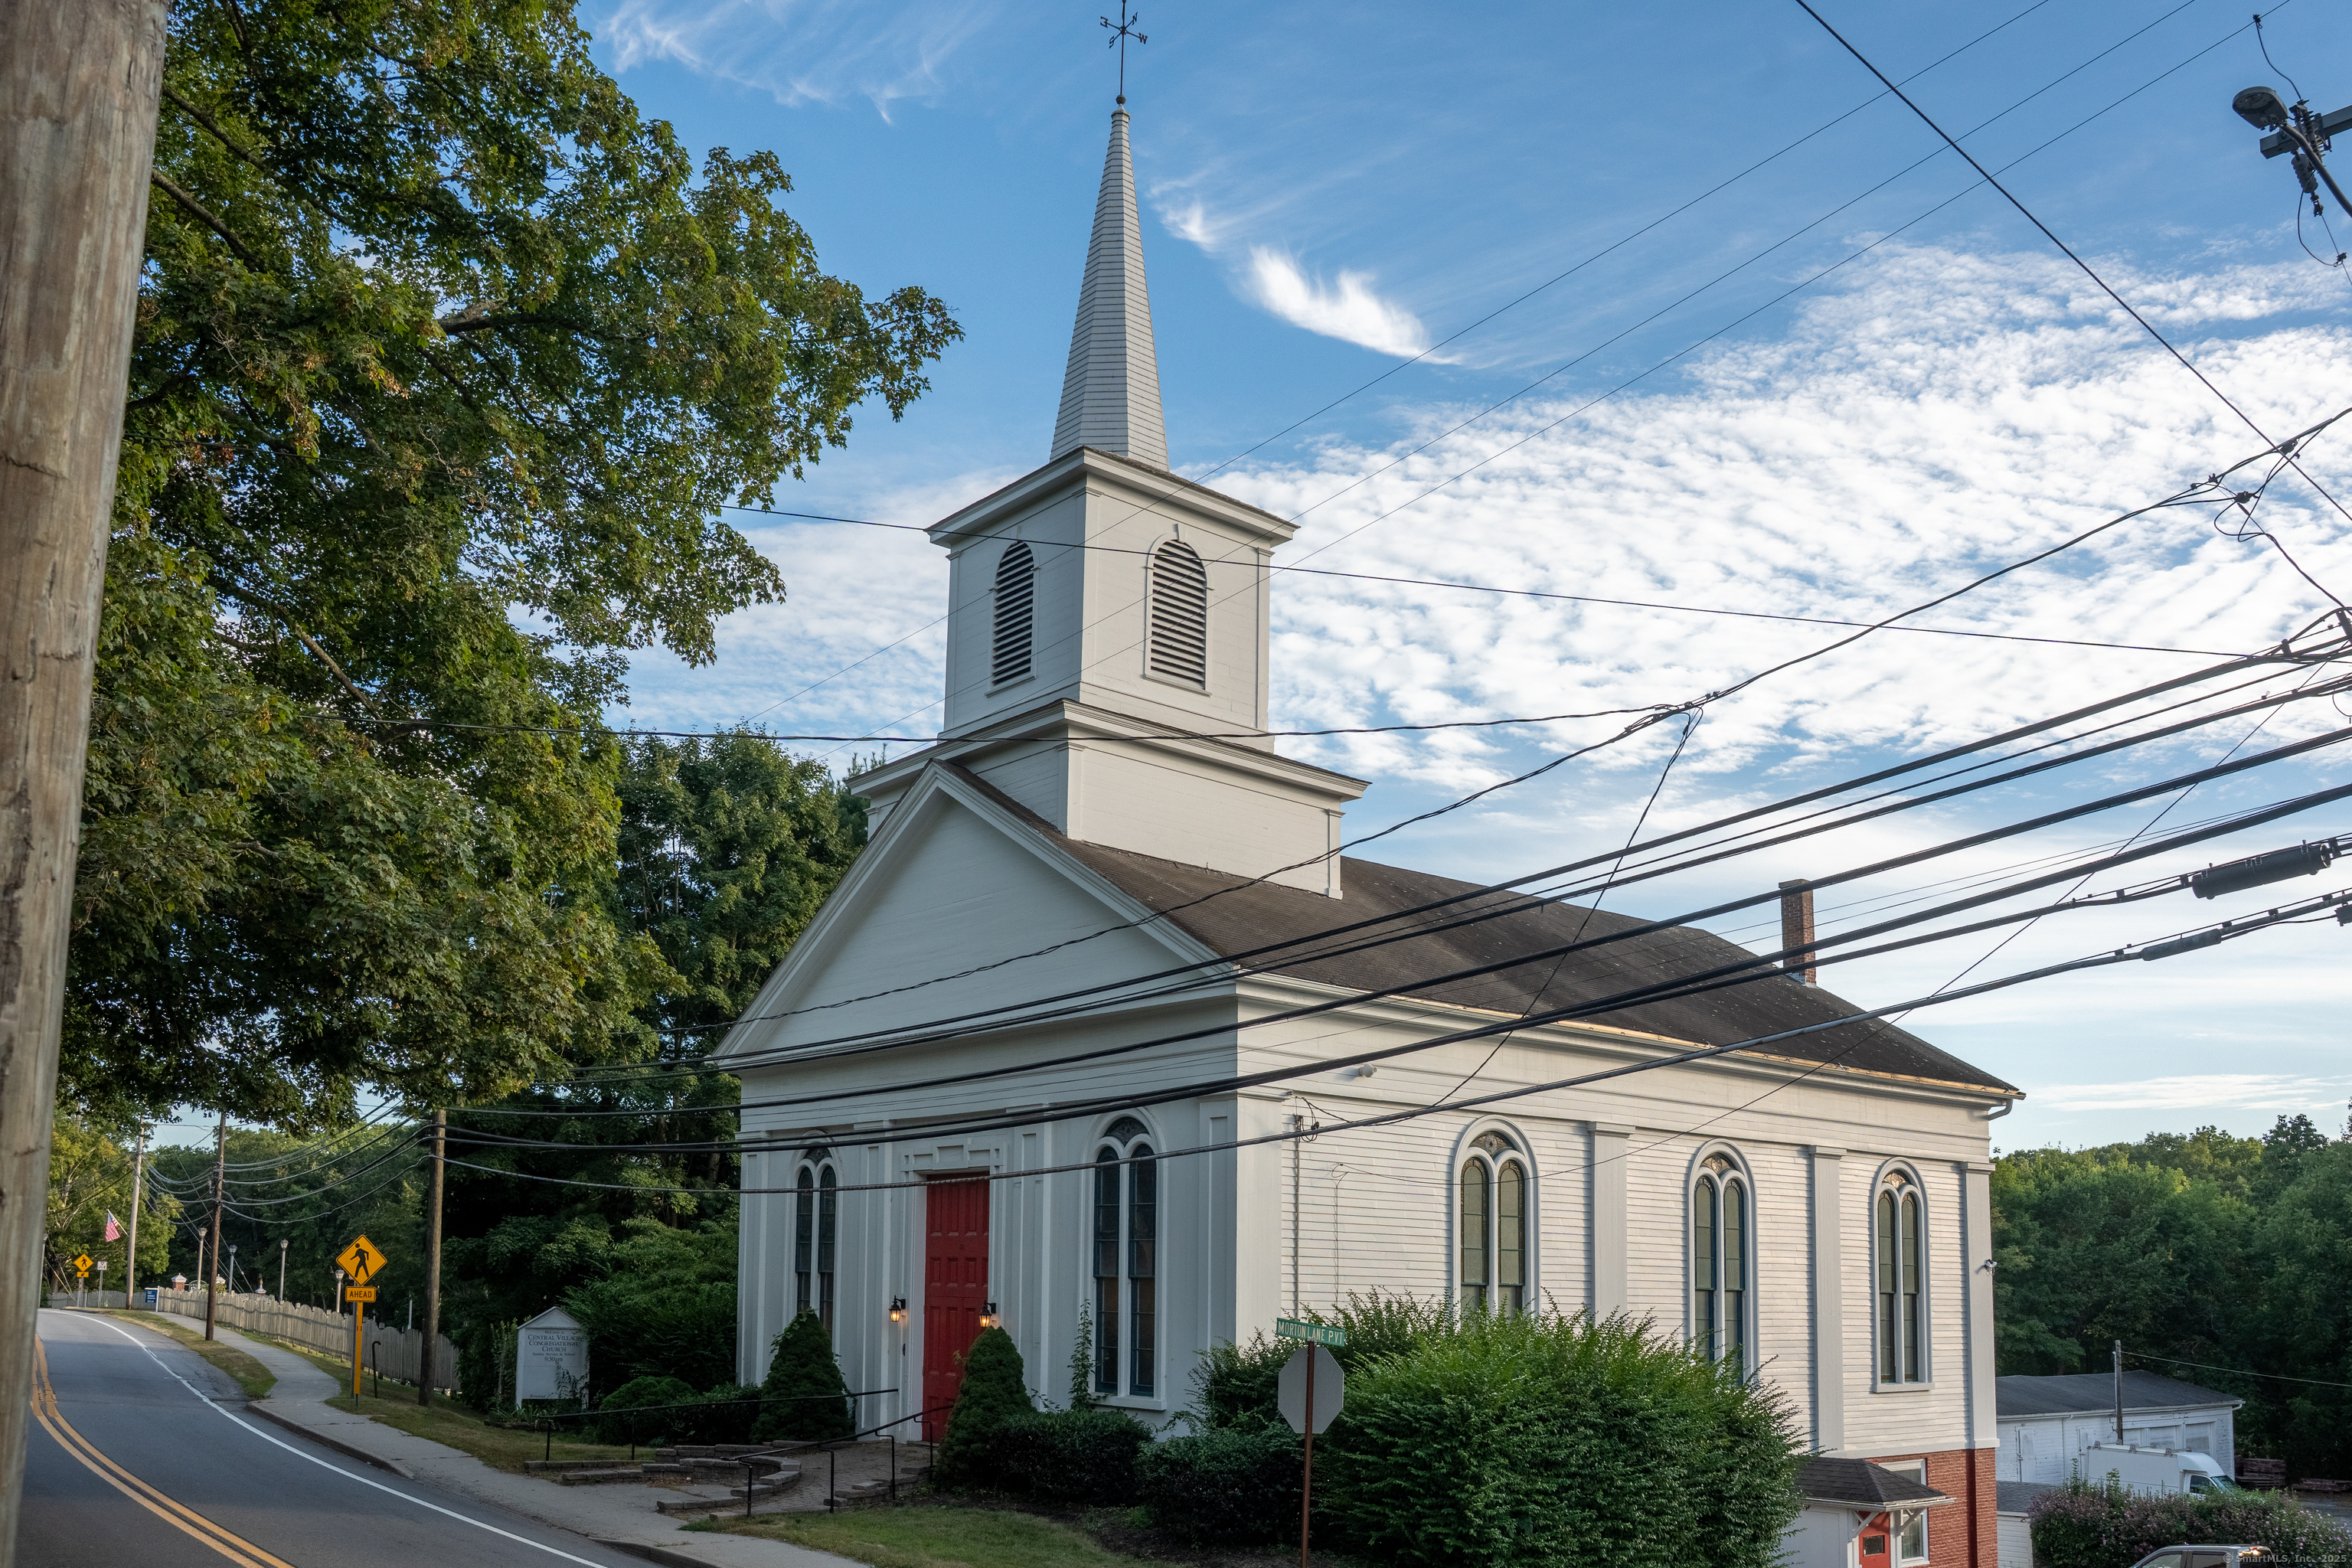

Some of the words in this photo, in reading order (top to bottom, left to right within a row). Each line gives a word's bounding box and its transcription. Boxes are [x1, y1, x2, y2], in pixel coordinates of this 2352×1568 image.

[1278, 1321, 1306, 1338] MORTON
[1308, 1327, 1325, 1341] LANE
[1328, 1331, 1343, 1344] PVT
